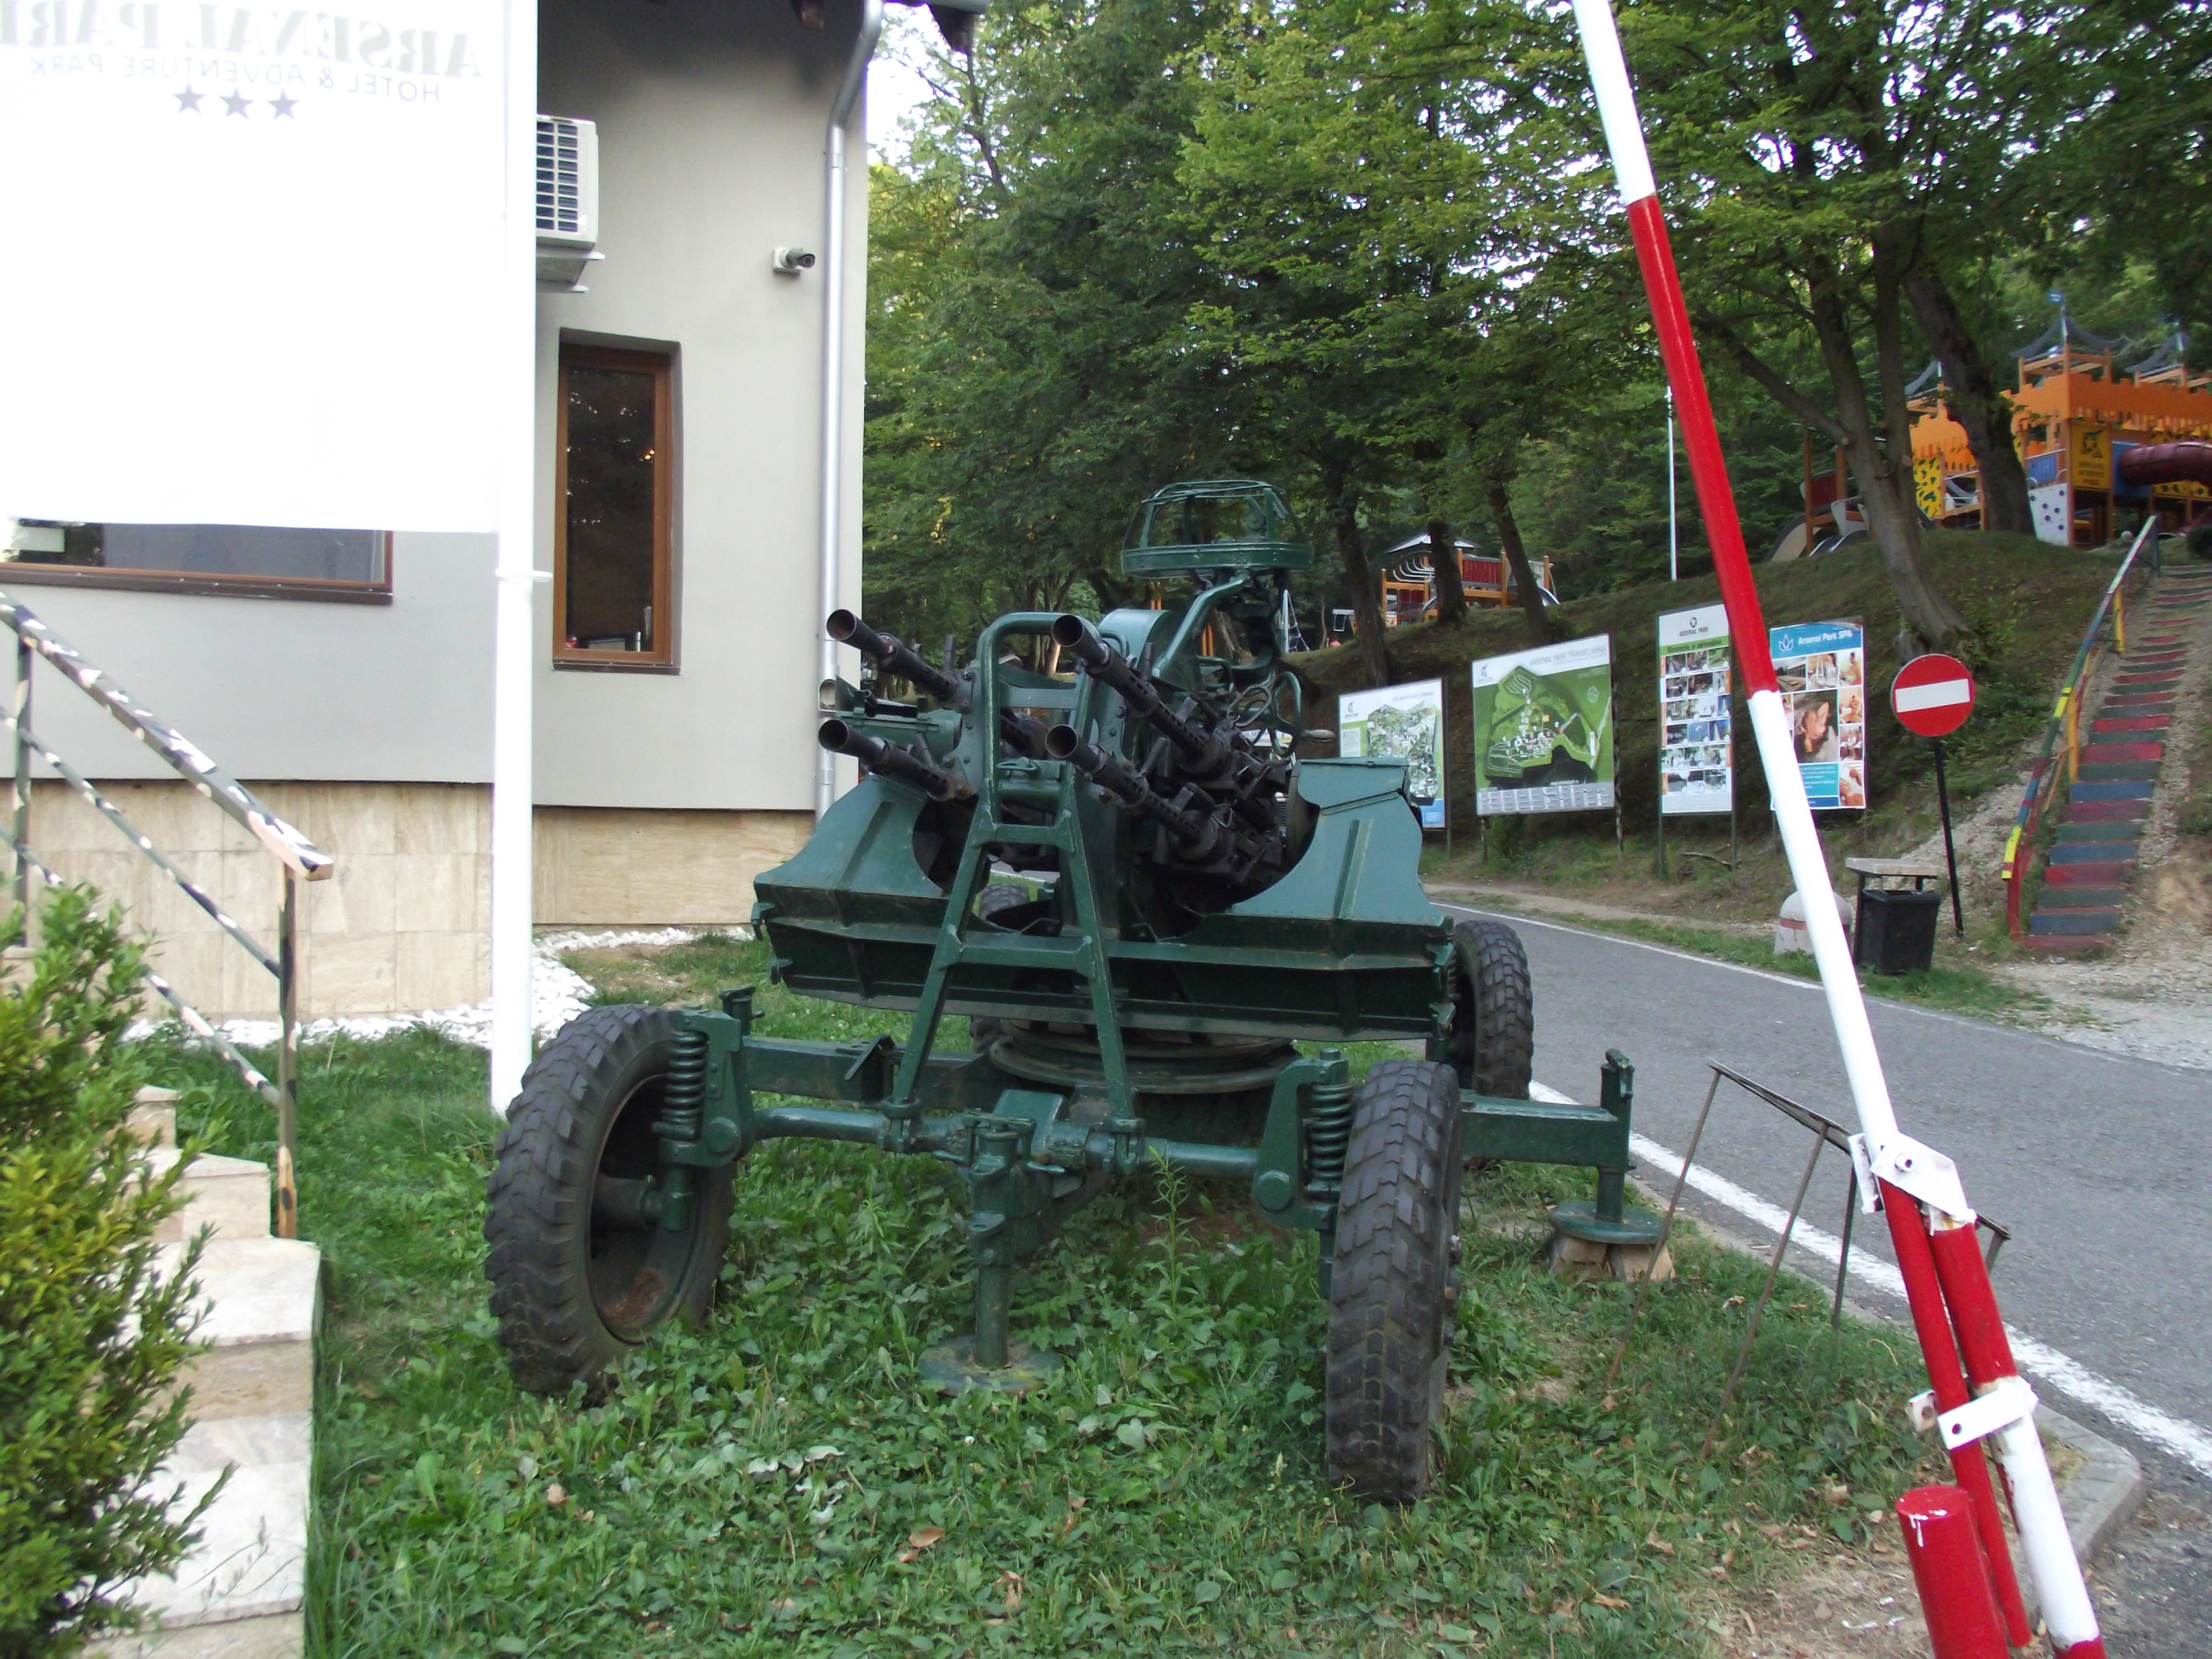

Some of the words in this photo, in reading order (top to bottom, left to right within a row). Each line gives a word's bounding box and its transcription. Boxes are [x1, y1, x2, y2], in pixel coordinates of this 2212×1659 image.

[1798, 634, 1822, 645] Arsenal
[1822, 632, 1838, 642] Park
[1838, 629, 1853, 639] SPA
